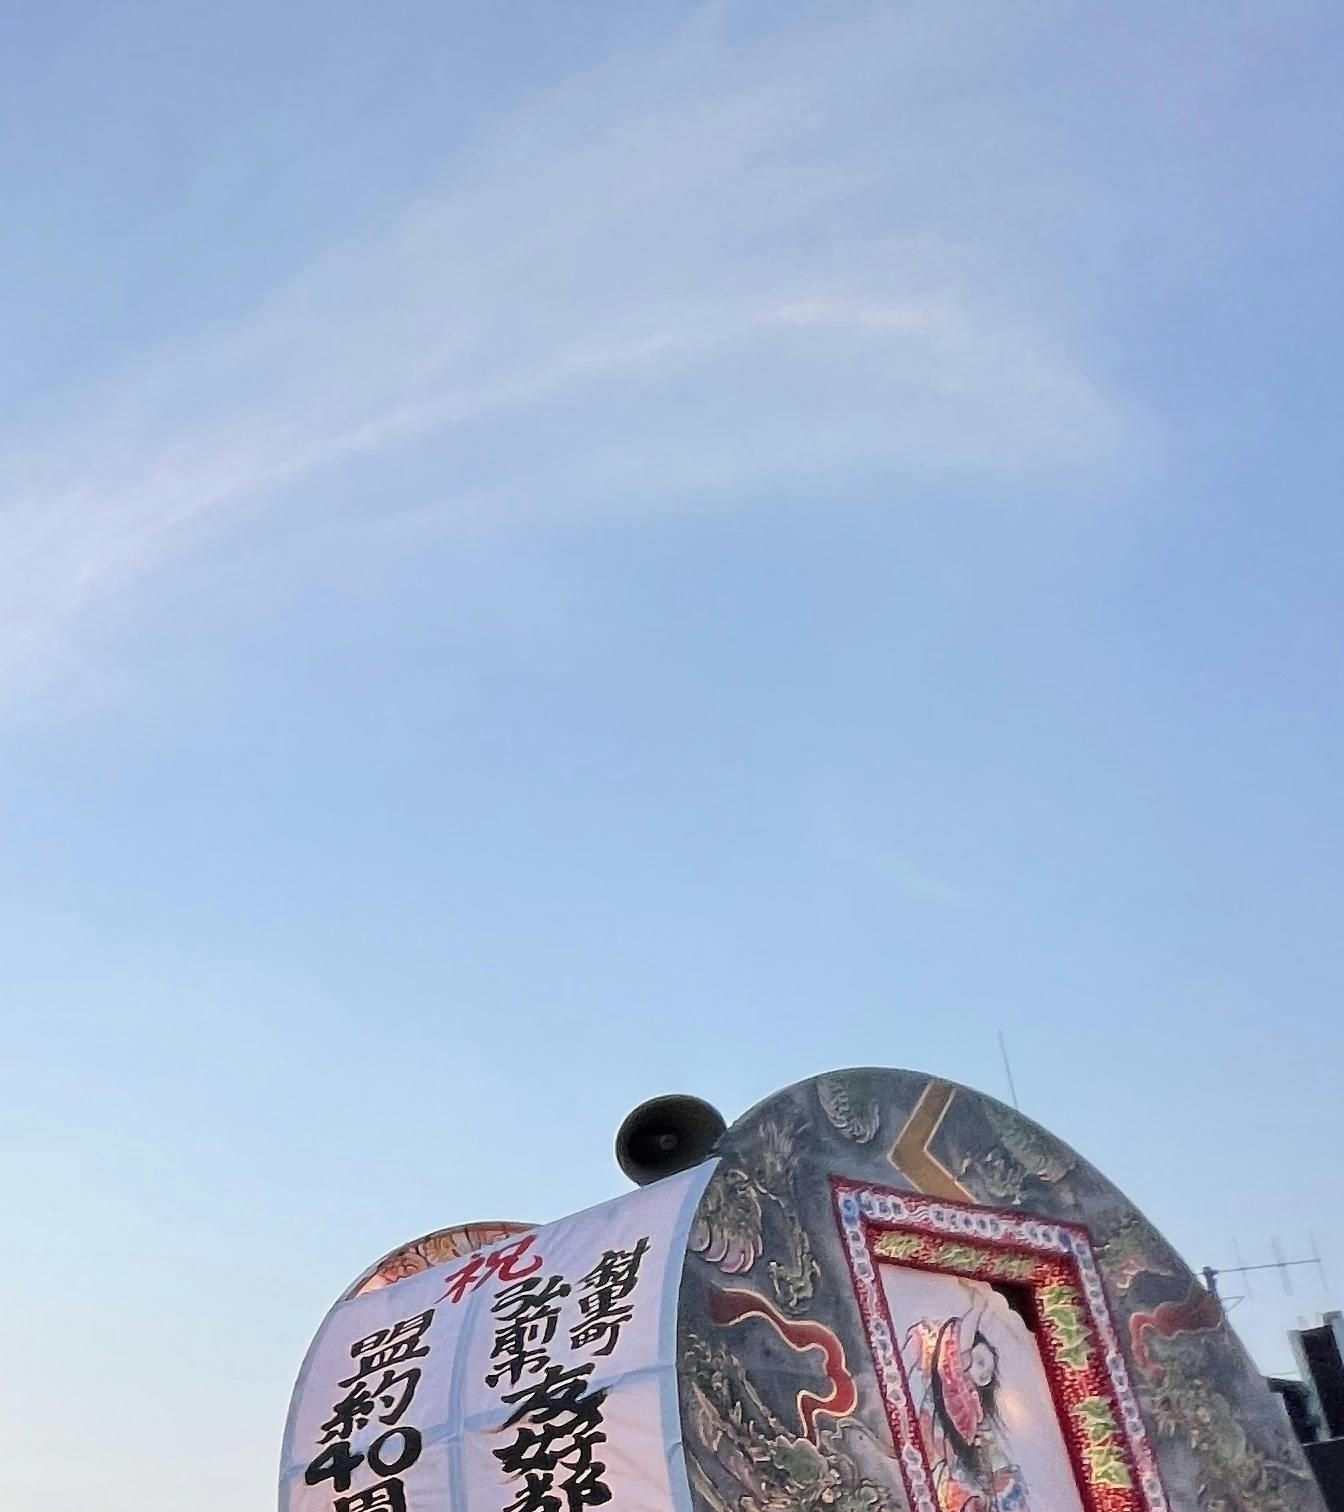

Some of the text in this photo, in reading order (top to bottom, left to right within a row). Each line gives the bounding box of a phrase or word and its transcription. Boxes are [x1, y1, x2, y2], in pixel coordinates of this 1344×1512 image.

[435, 1234, 544, 1305] 祝
[569, 1236, 650, 1356] 斜里町
[485, 1274, 572, 1389] 弘前市
